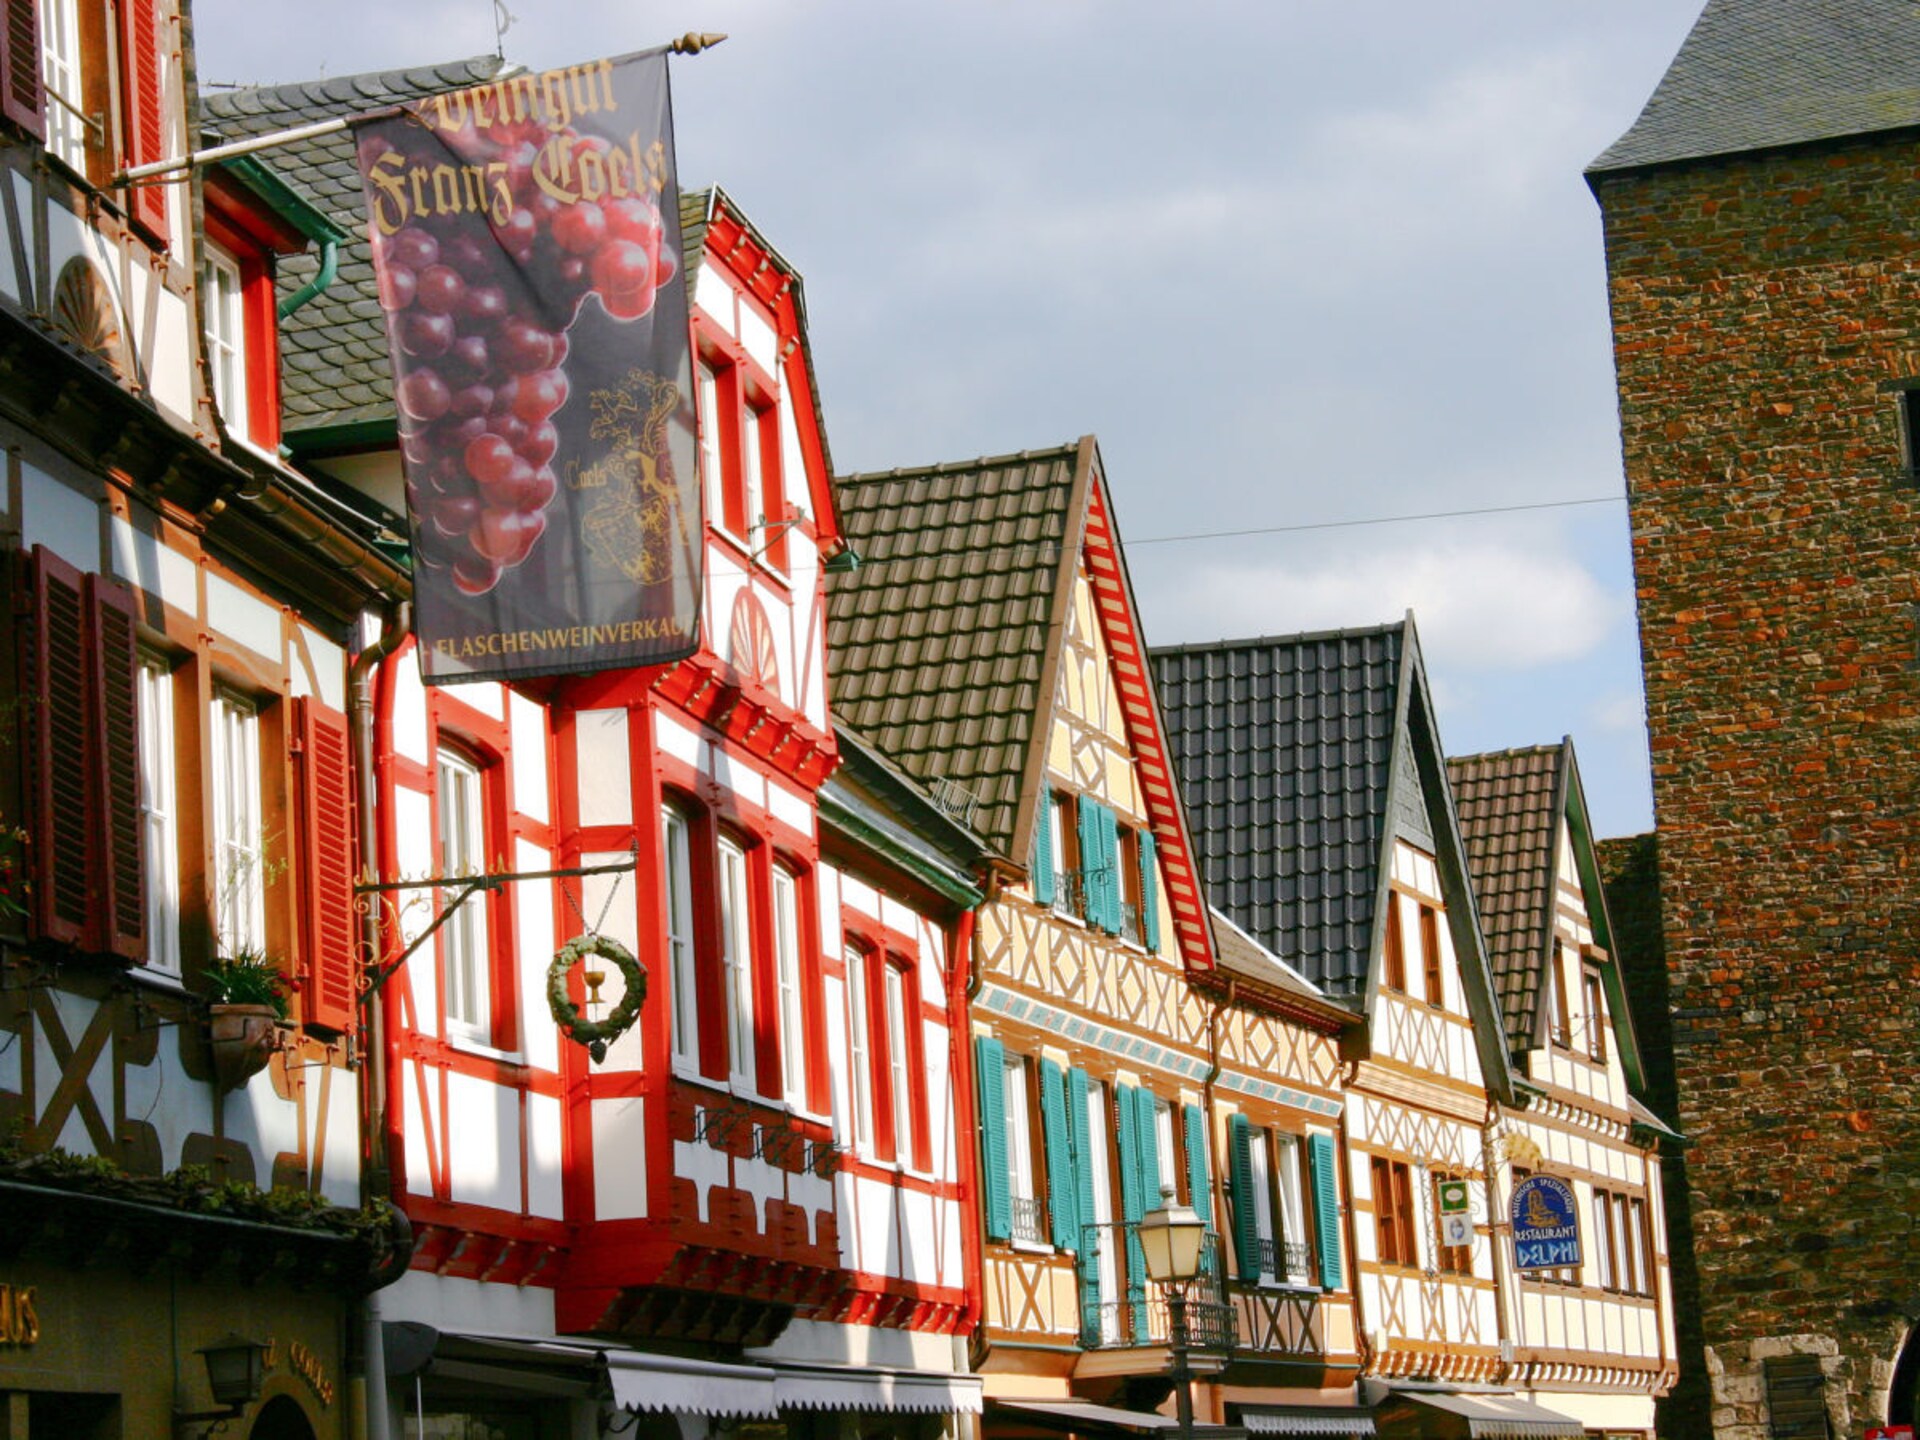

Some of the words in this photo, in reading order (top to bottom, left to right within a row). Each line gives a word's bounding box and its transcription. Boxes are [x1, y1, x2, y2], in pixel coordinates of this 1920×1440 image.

[369, 151, 513, 236] Franz
[531, 130, 668, 205] Coels
[1514, 1225, 1576, 1242] RESTAURANT
[1515, 1240, 1579, 1267] DELPHI
